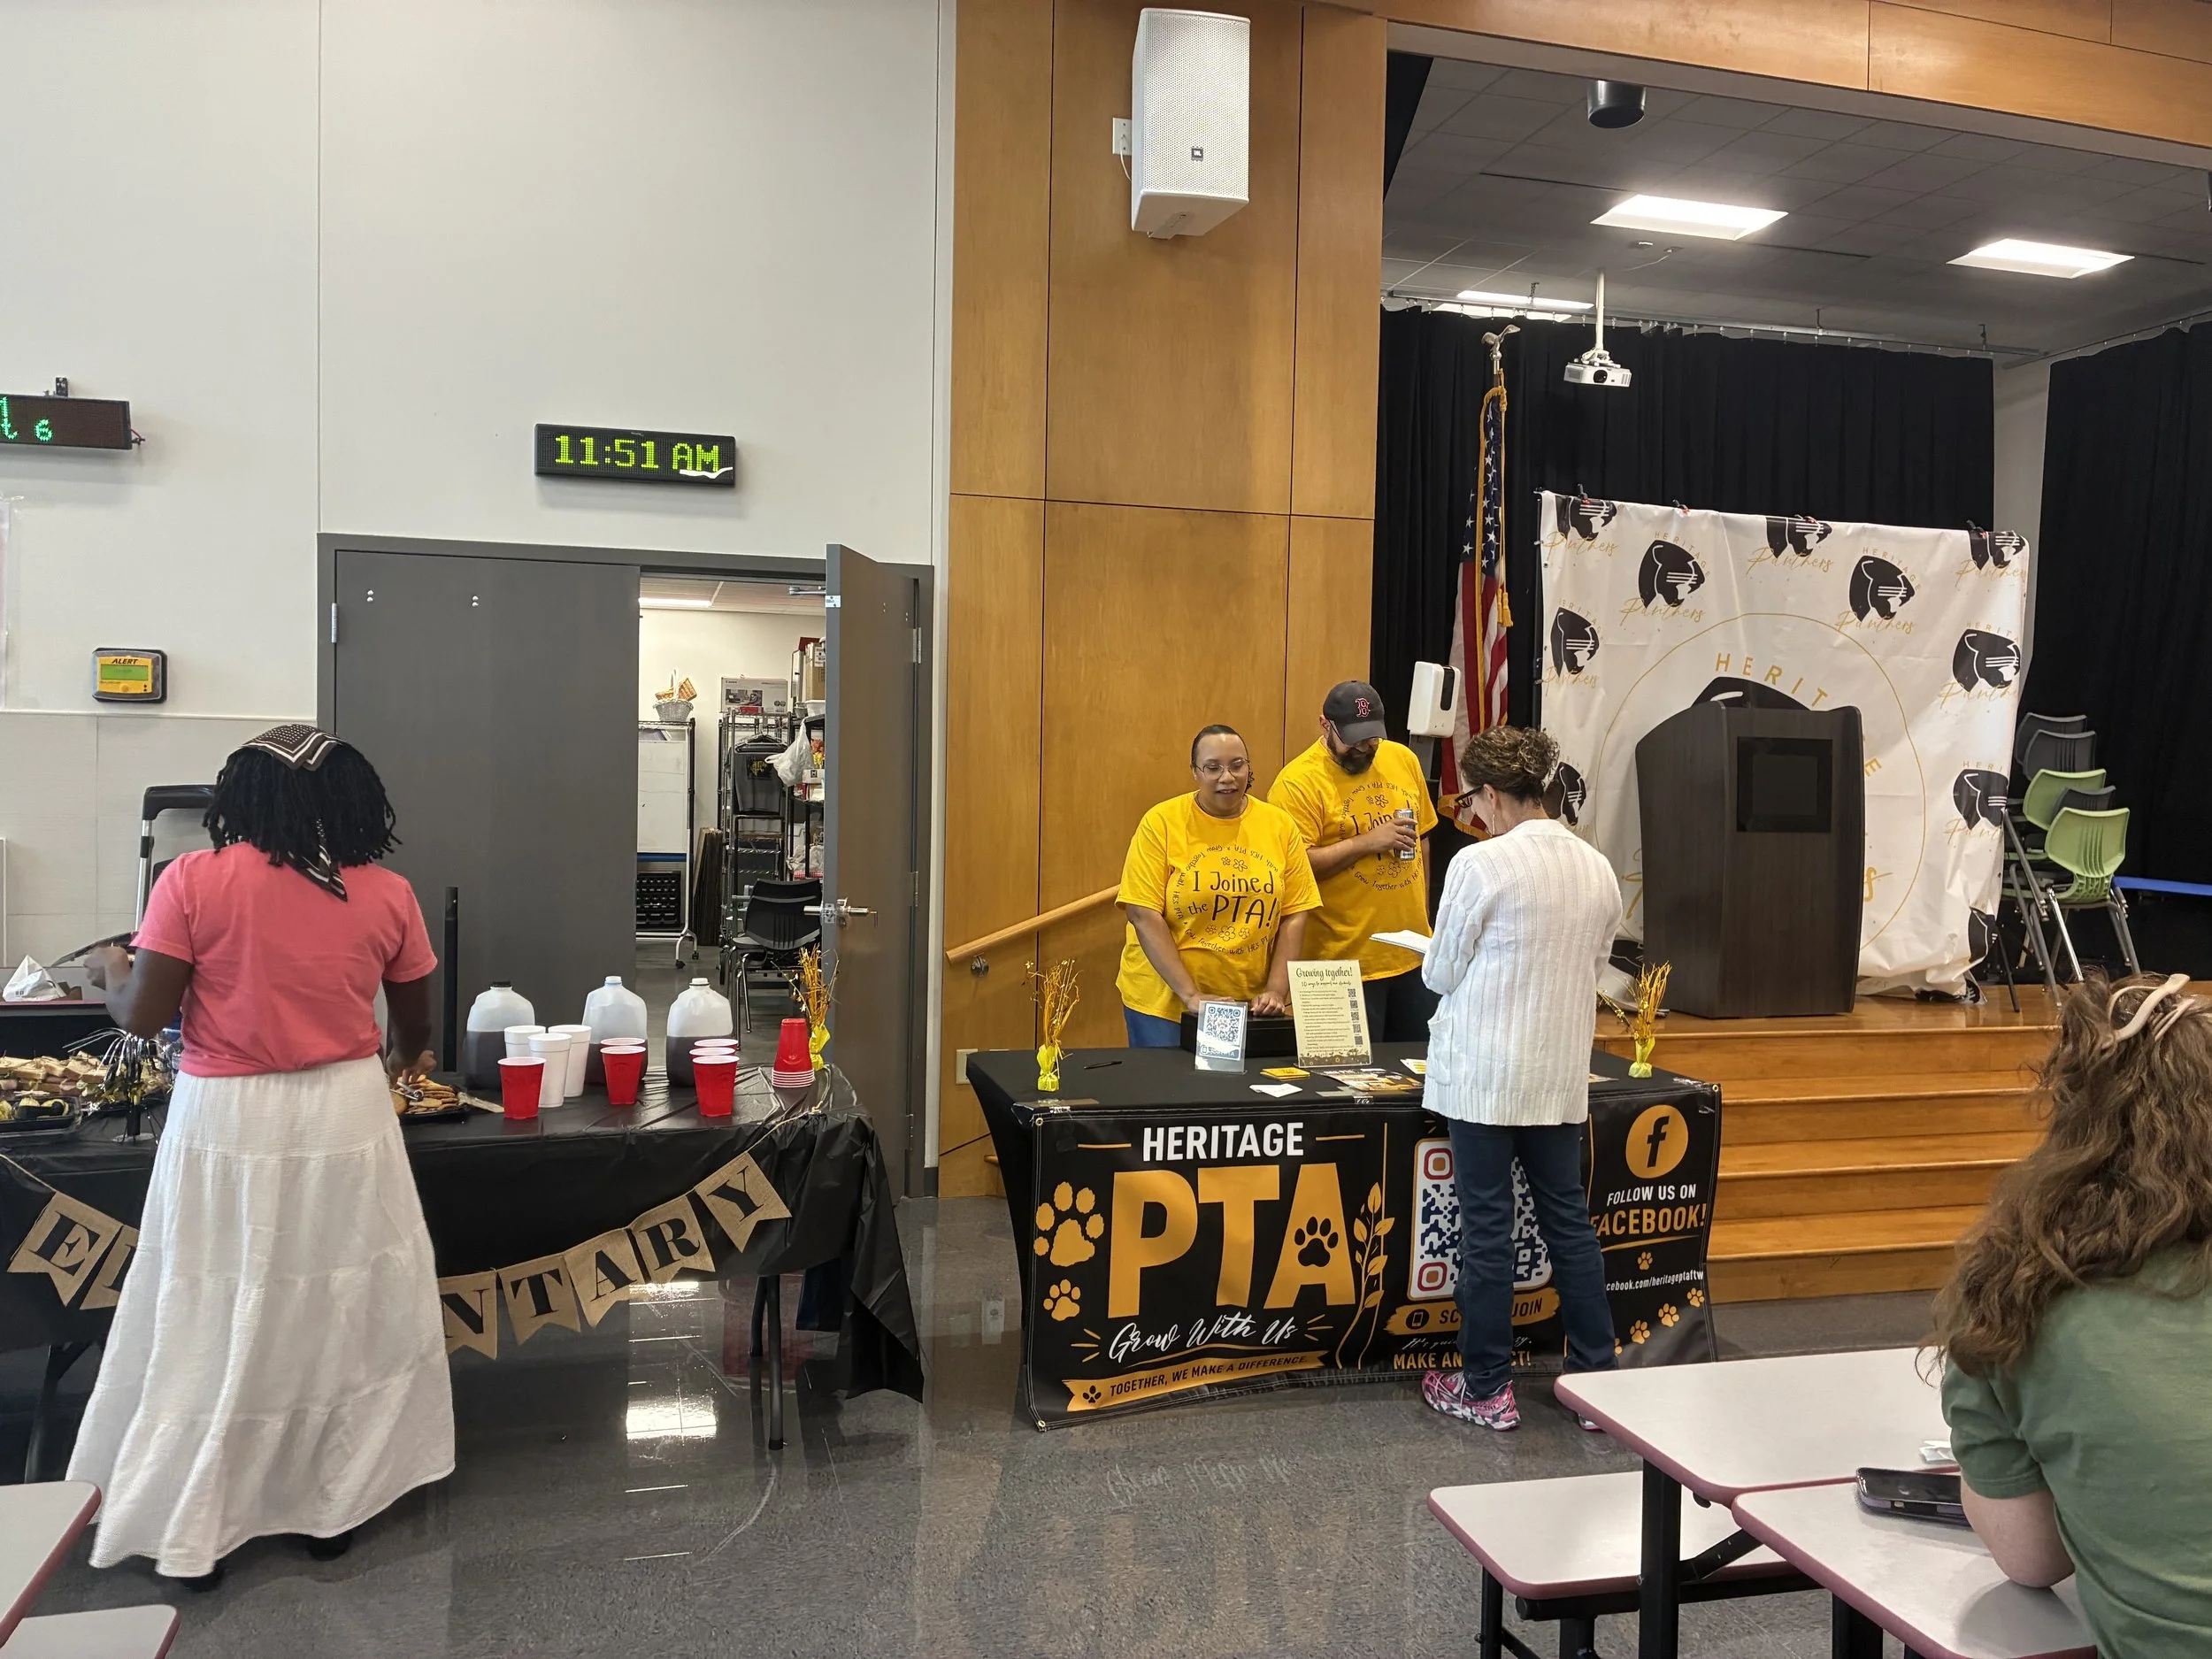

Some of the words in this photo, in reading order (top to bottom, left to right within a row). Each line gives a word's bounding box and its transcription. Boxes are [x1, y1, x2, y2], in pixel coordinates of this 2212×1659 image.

[35, 419, 53, 442] 6
[555, 435, 659, 469] 11:51
[672, 443, 718, 472] AM
[1863, 547, 1921, 591] HERITAGE
[1355, 697, 1371, 718] B
[1193, 871, 1201, 892] I
[1210, 870, 1274, 895] Joined
[1187, 901, 1209, 915] the
[1211, 894, 1277, 929] PTA!
[1296, 967, 1324, 981] Growing
[1325, 966, 1353, 980] together!
[1143, 1122, 1304, 1162] HERITAGE
[1607, 1186, 1654, 1206] FOLLOW
[1658, 1185, 1675, 1201] US
[1680, 1184, 1696, 1199] ON
[1108, 1162, 1356, 1319] PTA
[1606, 1270, 1703, 1291] cebook.com/heritageptaftw
[1109, 1322, 1180, 1363] Grow
[1187, 1311, 1256, 1348] With
[1261, 1317, 1298, 1345] Us
[1394, 1352, 1437, 1370] MAKE
[1110, 1374, 1168, 1397] TOGETHER,
[1171, 1371, 1188, 1382] WE
[1191, 1364, 1224, 1377] MAKE
[1238, 1356, 1308, 1371] DIFFERENCE.
